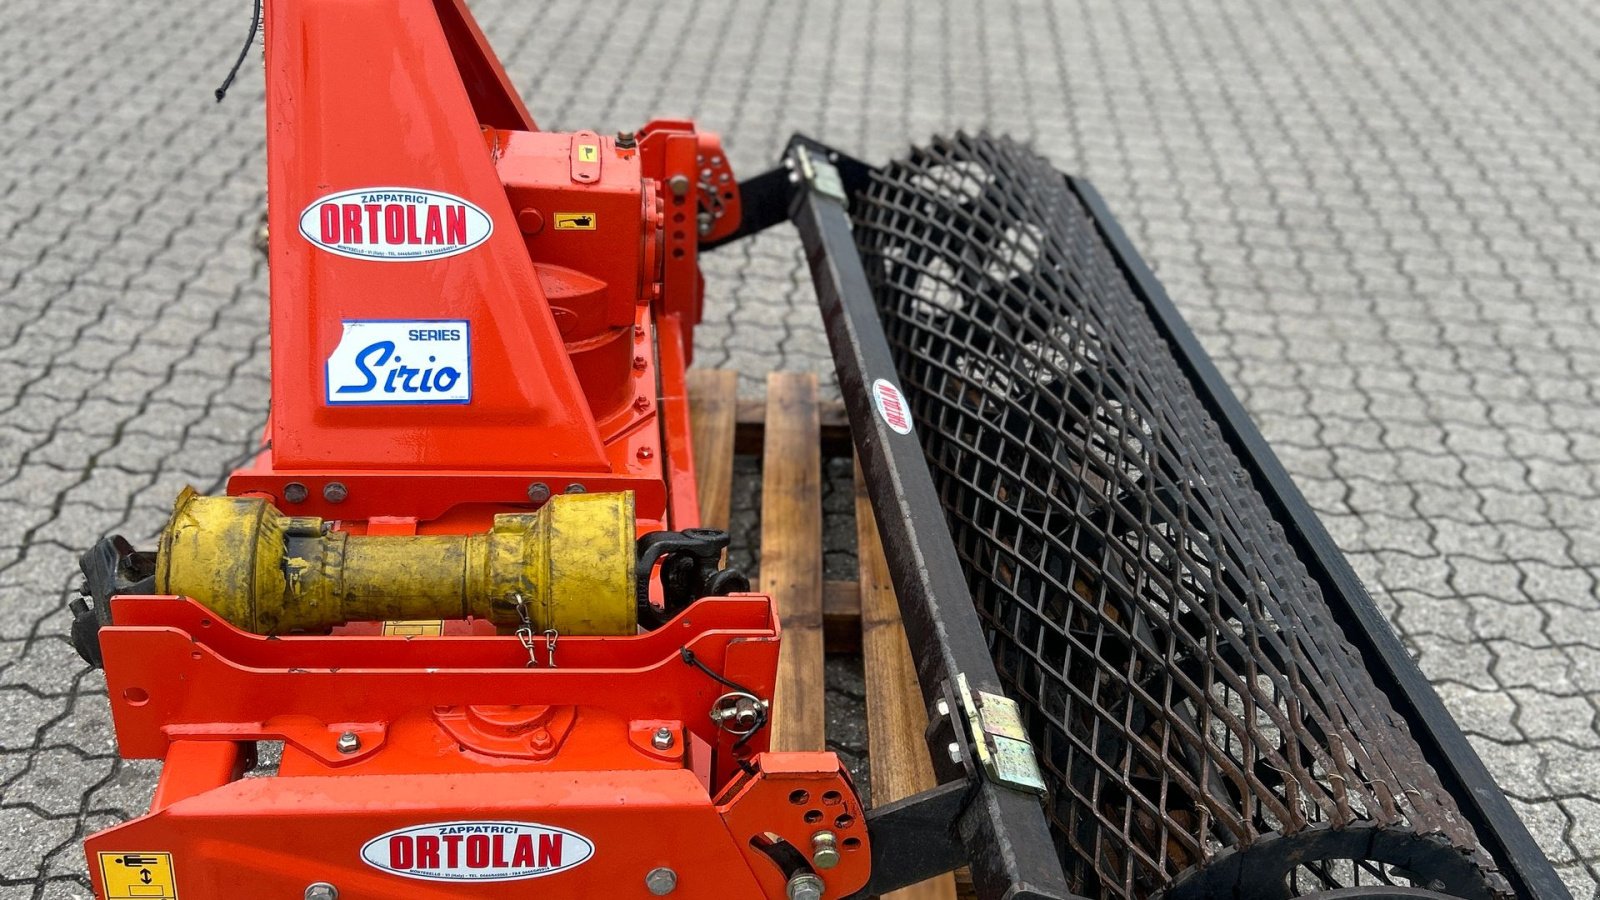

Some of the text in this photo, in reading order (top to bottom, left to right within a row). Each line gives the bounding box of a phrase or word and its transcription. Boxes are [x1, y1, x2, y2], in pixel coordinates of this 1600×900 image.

[361, 194, 428, 204] ZAPPATRICI
[320, 203, 468, 245] ORTOLAN
[408, 329, 460, 341] SERIES
[335, 340, 462, 393] Sirio
[878, 384, 908, 430] ORTOLAN
[439, 825, 519, 835] ZAPPATRICI
[389, 833, 564, 870] ORTOLAN
